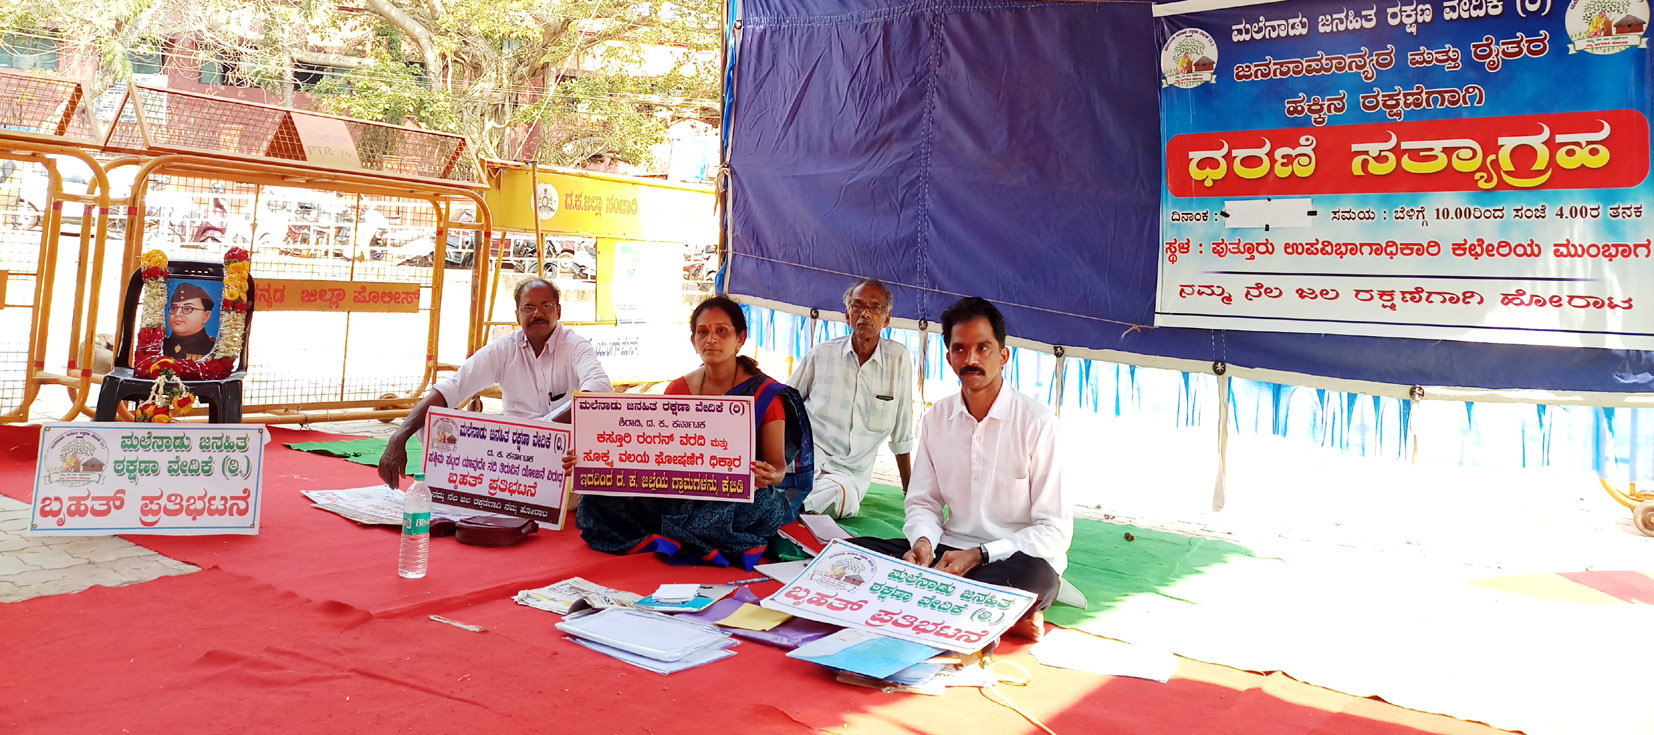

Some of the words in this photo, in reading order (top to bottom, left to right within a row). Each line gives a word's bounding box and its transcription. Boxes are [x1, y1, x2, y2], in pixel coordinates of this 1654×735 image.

[1232, 12, 1309, 42] ಮಲೆನಾಡು
[1318, 3, 1377, 34] ಜನಹಿತ
[1234, 44, 1395, 82] ಜನಸಾಮಾನ್ಯರ
[1408, 44, 1461, 71] ಮತ್ತು
[1471, 30, 1550, 72] ರೈತರ
[1285, 90, 1348, 126] ಹಕ್ಕಿನ
[1360, 84, 1485, 120] ರಕ್ಷಣೆಗಾಗಿ
[1188, 134, 1316, 187] ಧರಣಿ
[1351, 119, 1612, 189] ಸತ್ಯಾಗ್ರಹ
[1171, 209, 1209, 222] ದಿನಾಂಕ
[1331, 207, 1376, 222] ಸಮಯ
[1394, 206, 1428, 227] ಬೆಳಿಗ್ಗೆ
[1434, 206, 1505, 220] 10.00ರಿಂದ
[1512, 204, 1547, 220] ಸಂಜೆ
[1555, 204, 1600, 219] 4.00ರ
[1609, 203, 1643, 219] ತನಕ
[1165, 238, 1191, 264] ಸ್ಥಳ
[1211, 238, 1275, 260] ಪುತ್ತೂರು
[1284, 238, 1442, 260] ಉಪವಿಭಾಗಾಧಿಕಾರಿ
[1451, 238, 1542, 260] ಕಛೇರಿಯ
[1553, 238, 1652, 261] ಮುಂಭಾಗ
[301, 287, 347, 309] ಜಿಲ್ಲಾ
[1178, 284, 1233, 305] ನಮ್ಮ
[1245, 282, 1283, 301] ನೆಲ
[1295, 287, 1340, 301] ಜಲ
[1354, 286, 1484, 311] ರಕ್ಷಣೆಗಾಗಿ
[1500, 289, 1634, 311] ಹೋರಾಟ
[579, 400, 622, 411] ಮಲೆನಾಡು
[627, 400, 658, 412] ಜನಹಿತ
[663, 401, 690, 416] ರಕ್ಷಣಾ
[695, 401, 724, 413] ವೇದಿಕೆ
[672, 420, 706, 429] ಕರ್ನಾಟಕ
[121, 432, 192, 453] ಮಲೆನಾಡು
[199, 432, 250, 452] ಜನಹಿತ
[597, 431, 632, 448] ಕಸ್ತೂರಿ
[636, 432, 674, 447] ರಂಗನ್
[679, 433, 706, 447] ವರದಿ
[710, 438, 728, 451] ಮತ್ತು
[113, 456, 161, 485] ರಕ್ಷಣಾ
[167, 456, 214, 477] ವೇದಿಕೆ
[619, 450, 650, 464] ವಲಯ
[655, 451, 704, 467] ಘೋಷಣೆಗೆ
[709, 454, 742, 472] ಧಿಕ್ಕಾರ
[448, 471, 484, 490] ಬೃಹತ್
[488, 475, 537, 497] ಪ್ರತಿಭಟನೆ
[39, 488, 126, 527] ಬೃಹತ್
[139, 488, 251, 527] ಪ್ರತಿಭಟನೆ
[869, 581, 915, 603] ರಕ್ಷಣಾ
[917, 595, 970, 617] ವೇದಿಕೆ
[887, 568, 957, 596] ಮಲೆನಾಡು
[959, 586, 1017, 611] ಜನಹಿತ
[783, 584, 868, 615] ಬೃಹತ್
[864, 608, 990, 645] ಪ್ರತಿಭಟನೆ
